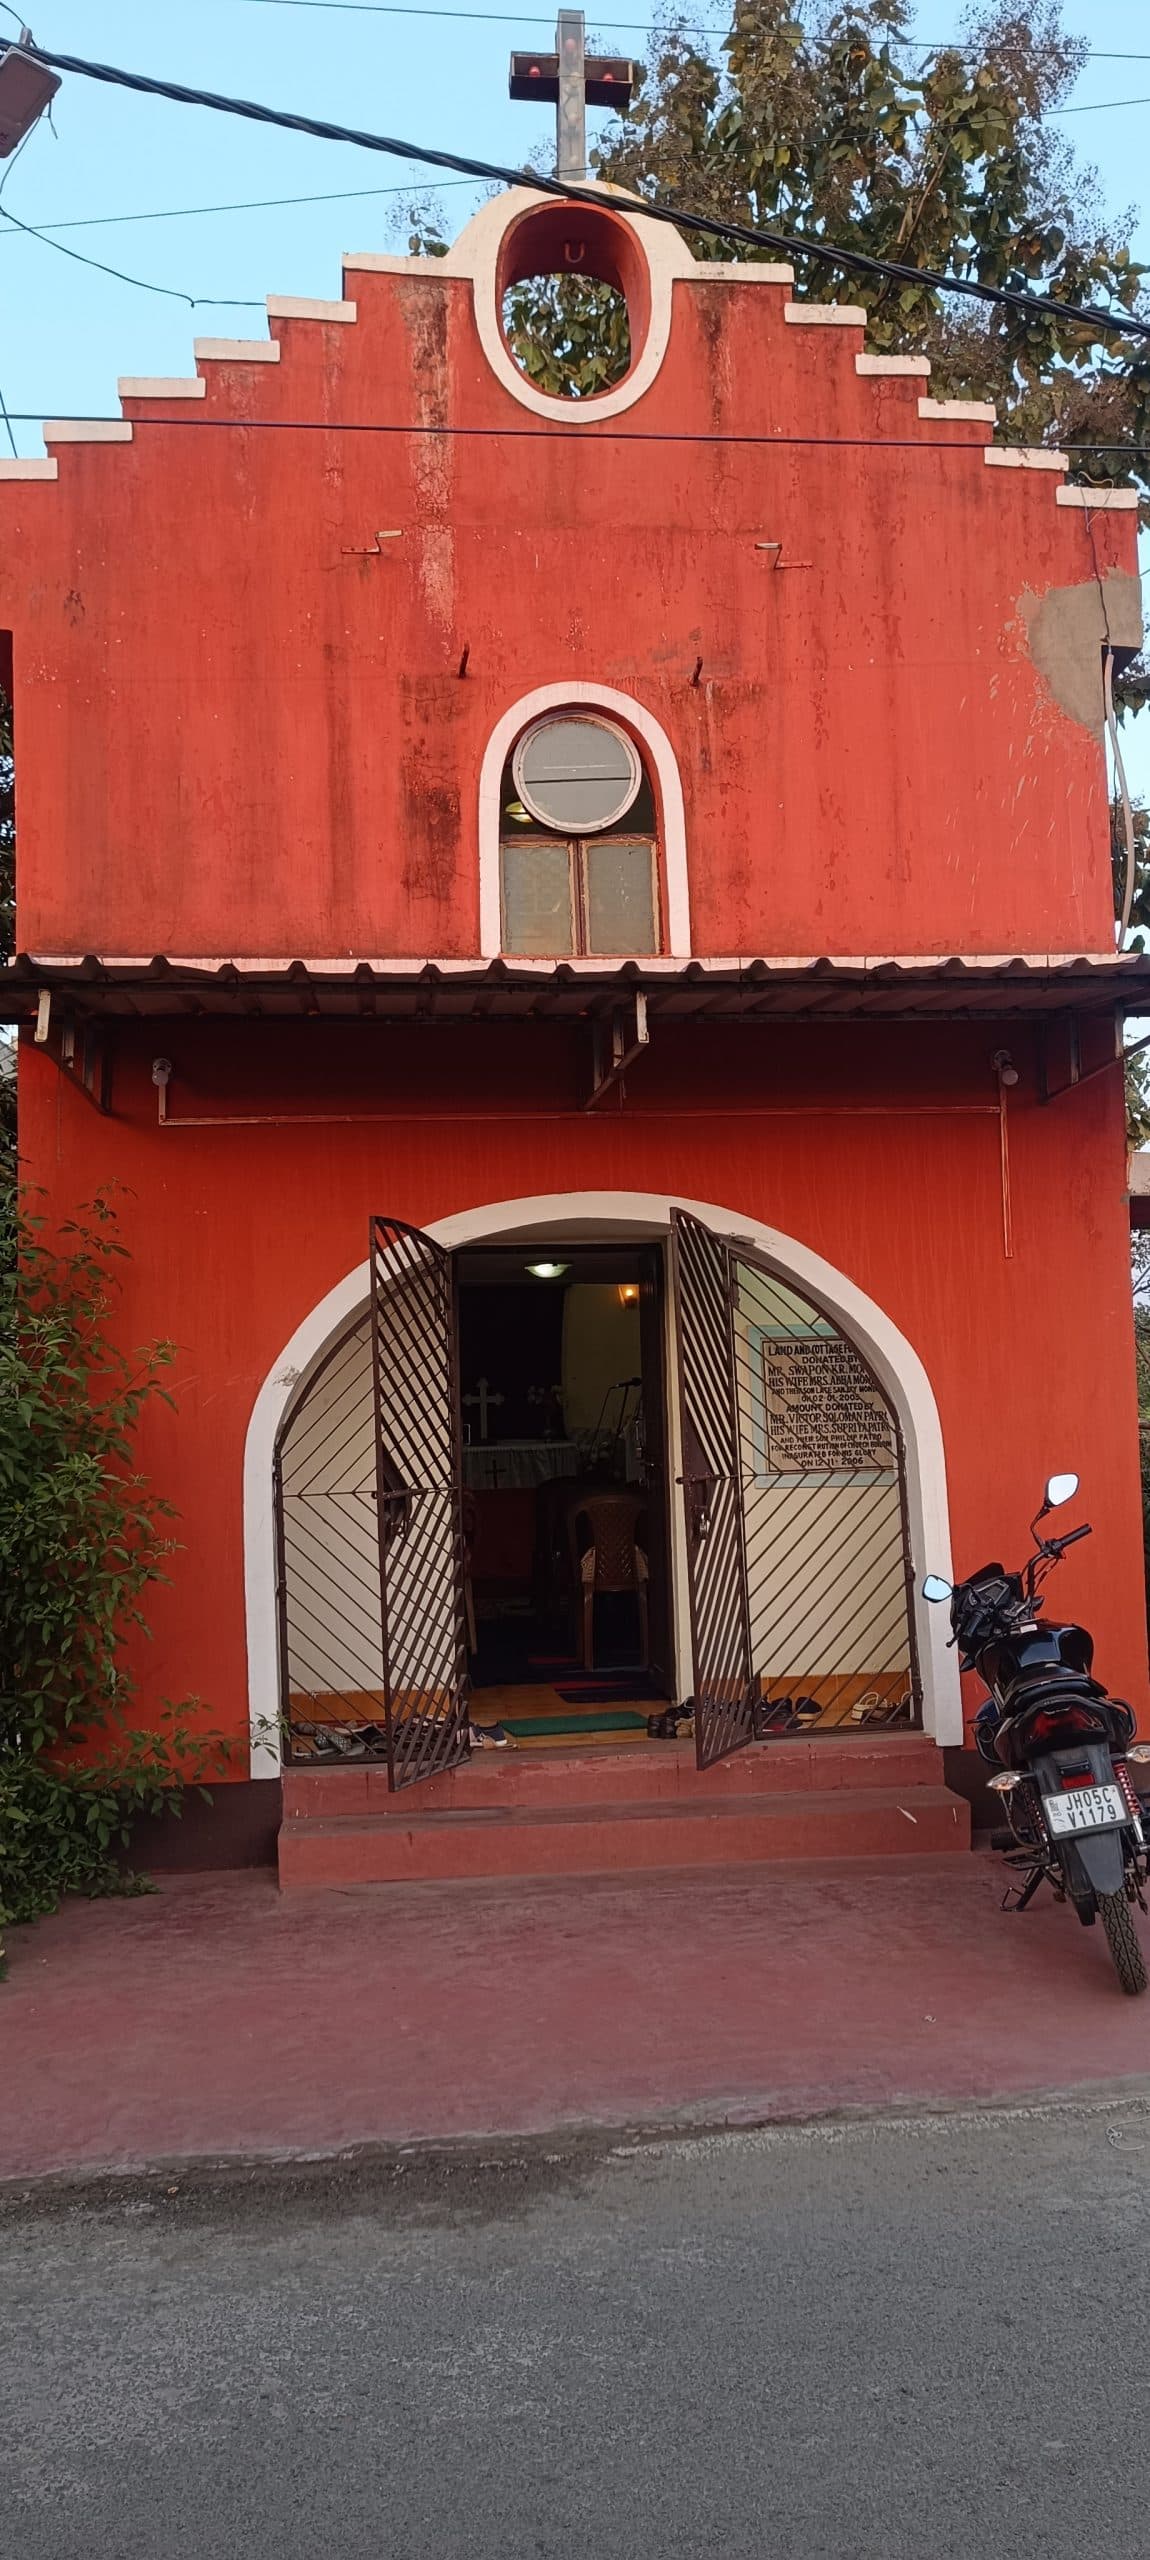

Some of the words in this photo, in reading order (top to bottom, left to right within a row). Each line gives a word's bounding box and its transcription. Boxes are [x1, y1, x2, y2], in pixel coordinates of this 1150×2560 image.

[768, 1345, 793, 1356] LAND
[794, 1345, 811, 1355] AND
[802, 1355, 846, 1364] DONATED
[768, 1377, 784, 1387] HIS
[785, 1376, 809, 1387] WIFE
[786, 1403, 823, 1412] AMOUNT
[825, 1402, 864, 1411] DONATED
[788, 1412, 822, 1423] VICTOR
[770, 1425, 786, 1435] HIS
[786, 1424, 809, 1434] WIFE
[780, 1436, 795, 1444] AND
[1066, 1787, 1112, 1811] JH05C
[1067, 1804, 1117, 1828] V1179
